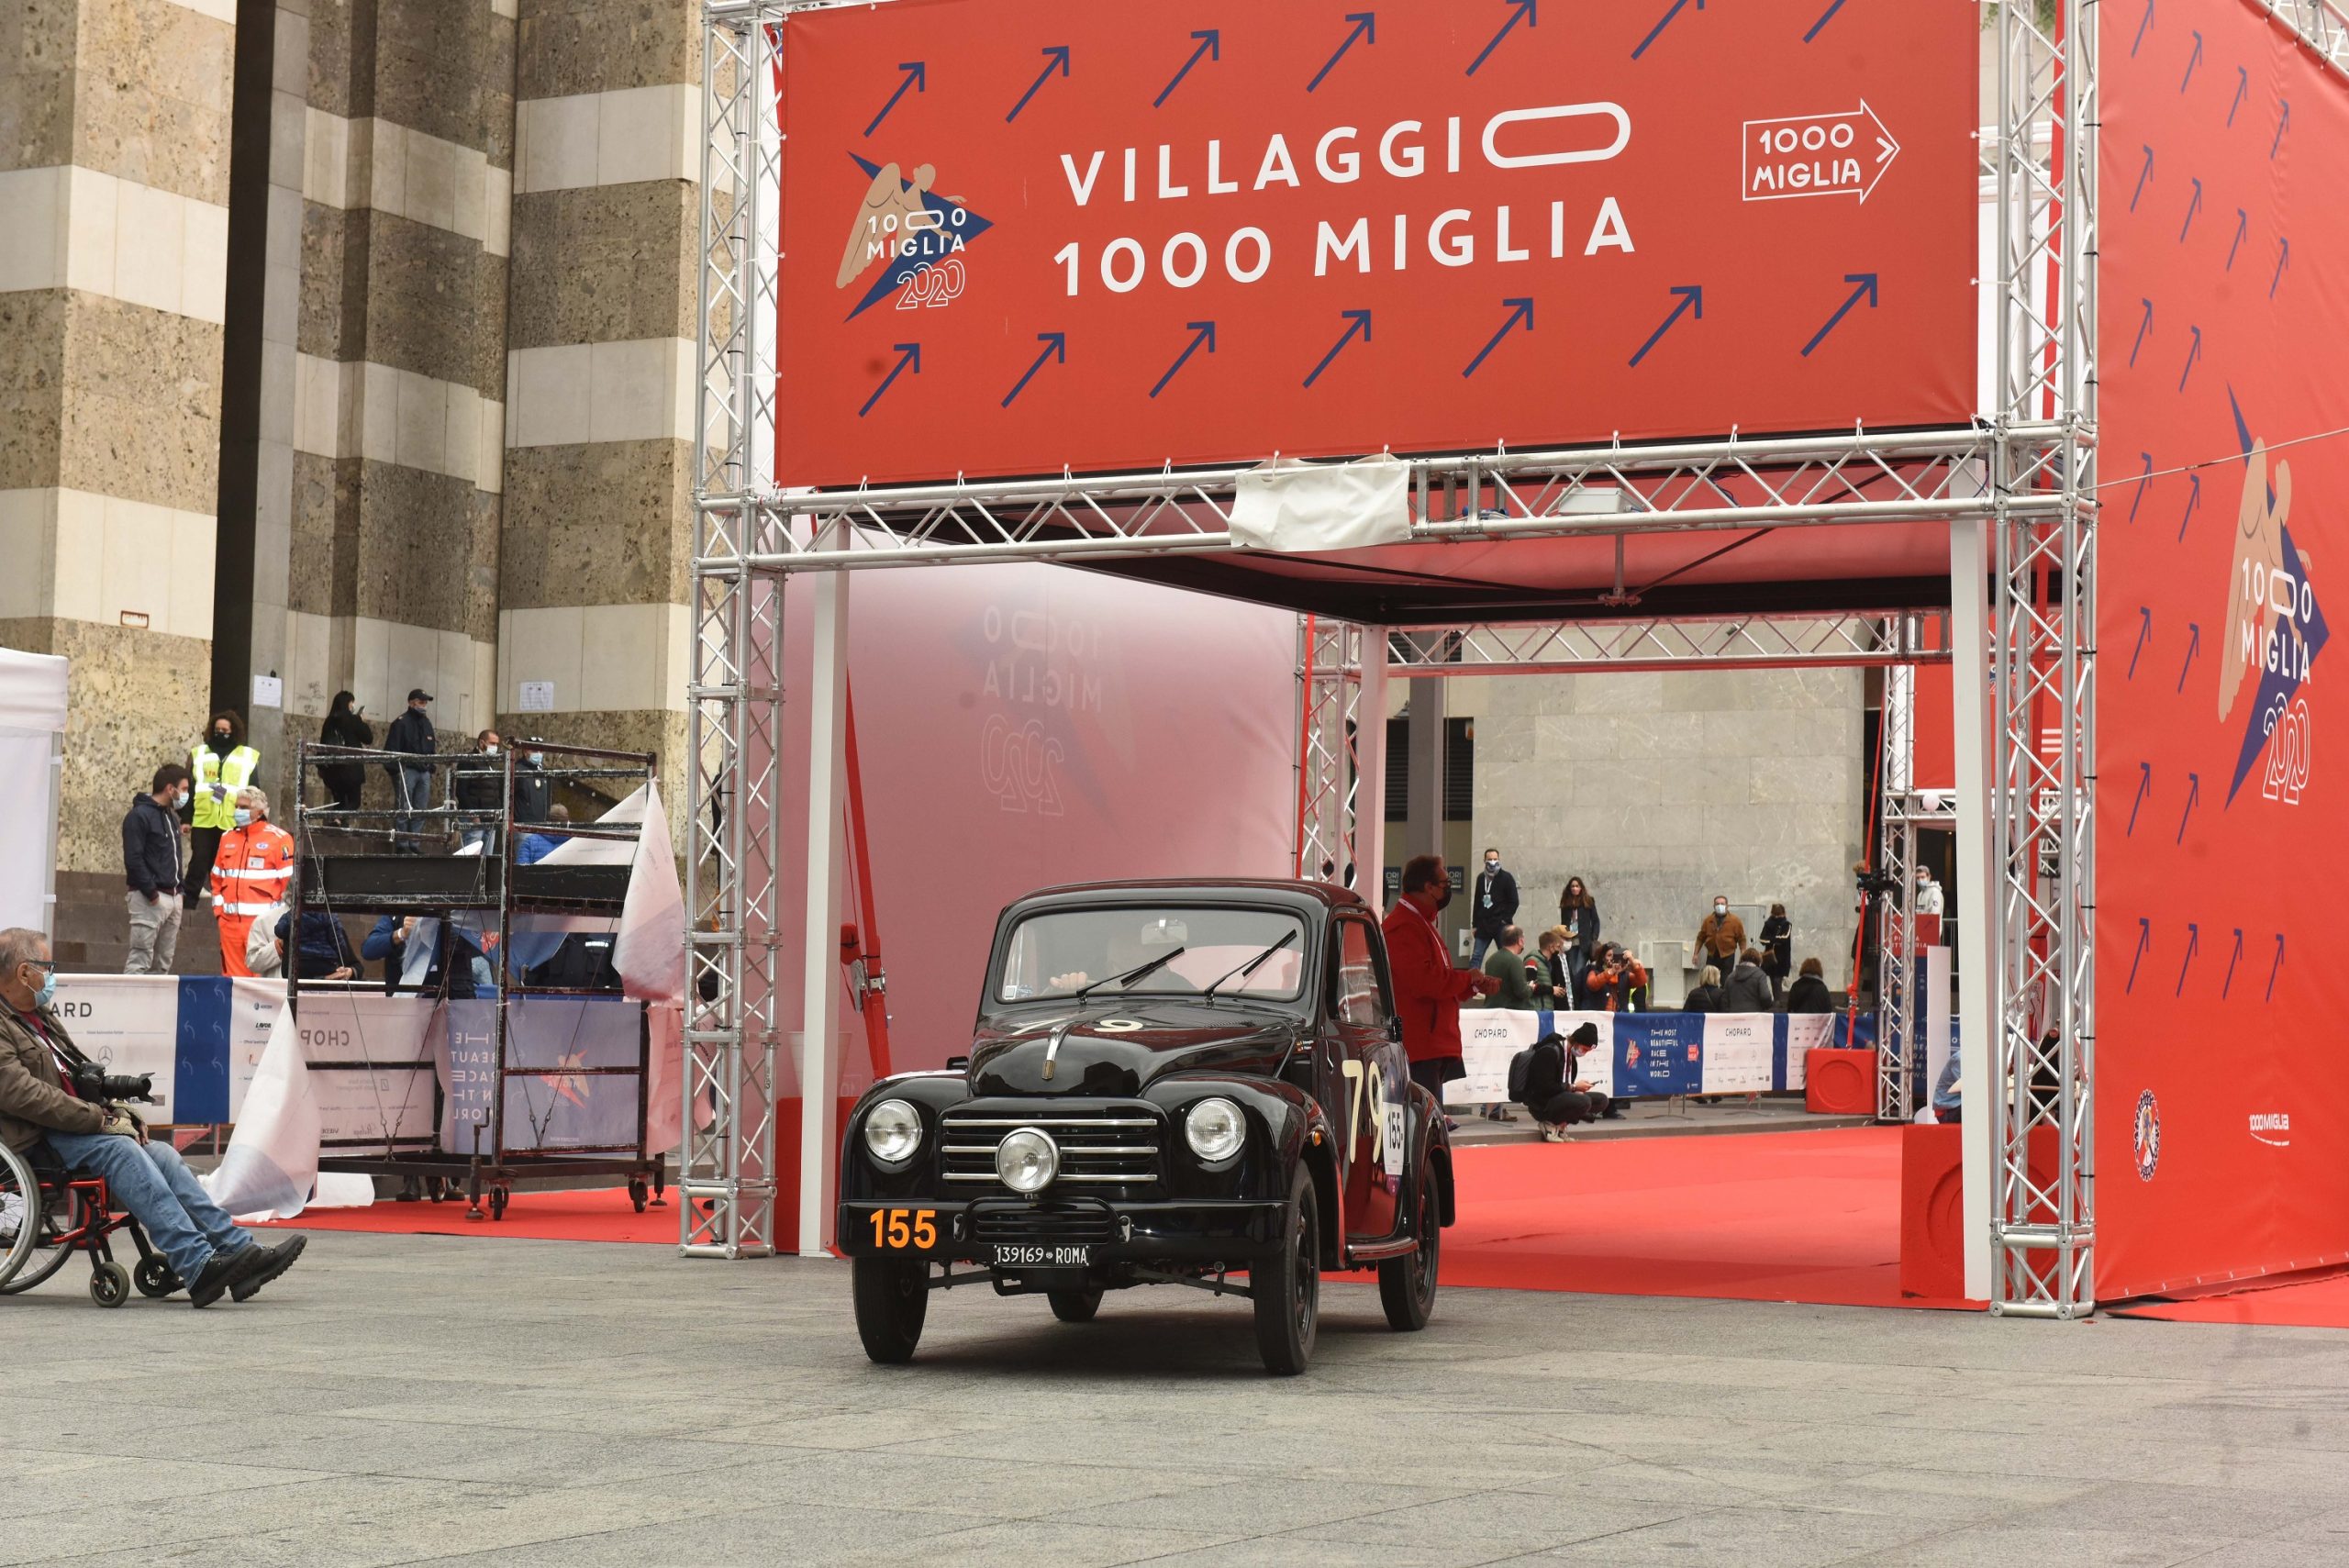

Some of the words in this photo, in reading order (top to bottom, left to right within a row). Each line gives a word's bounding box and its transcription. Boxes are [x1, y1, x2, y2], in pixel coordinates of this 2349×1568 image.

[1060, 101, 1631, 206] VILLAGGIO
[1759, 123, 1854, 155] 1000
[1752, 158, 1861, 192] MIGLIA
[866, 234, 966, 261] MIGLIA
[1053, 227, 1272, 296] 1000
[1314, 196, 1635, 277] MIGLIA
[896, 259, 965, 310] 2020
[2241, 618, 2311, 684] MIGLIA
[2262, 692, 2310, 806] 2020
[1474, 1028, 1508, 1039] CHOPARD
[1650, 1039, 1678, 1047] BEAUTIFUL
[1725, 1028, 1752, 1037] CHOPARD
[1341, 1059, 1384, 1163] 79
[1386, 1111, 1401, 1150] 155
[870, 1208, 937, 1249] 155
[996, 1246, 1044, 1263] 139169
[1054, 1247, 1088, 1264] ROMA
